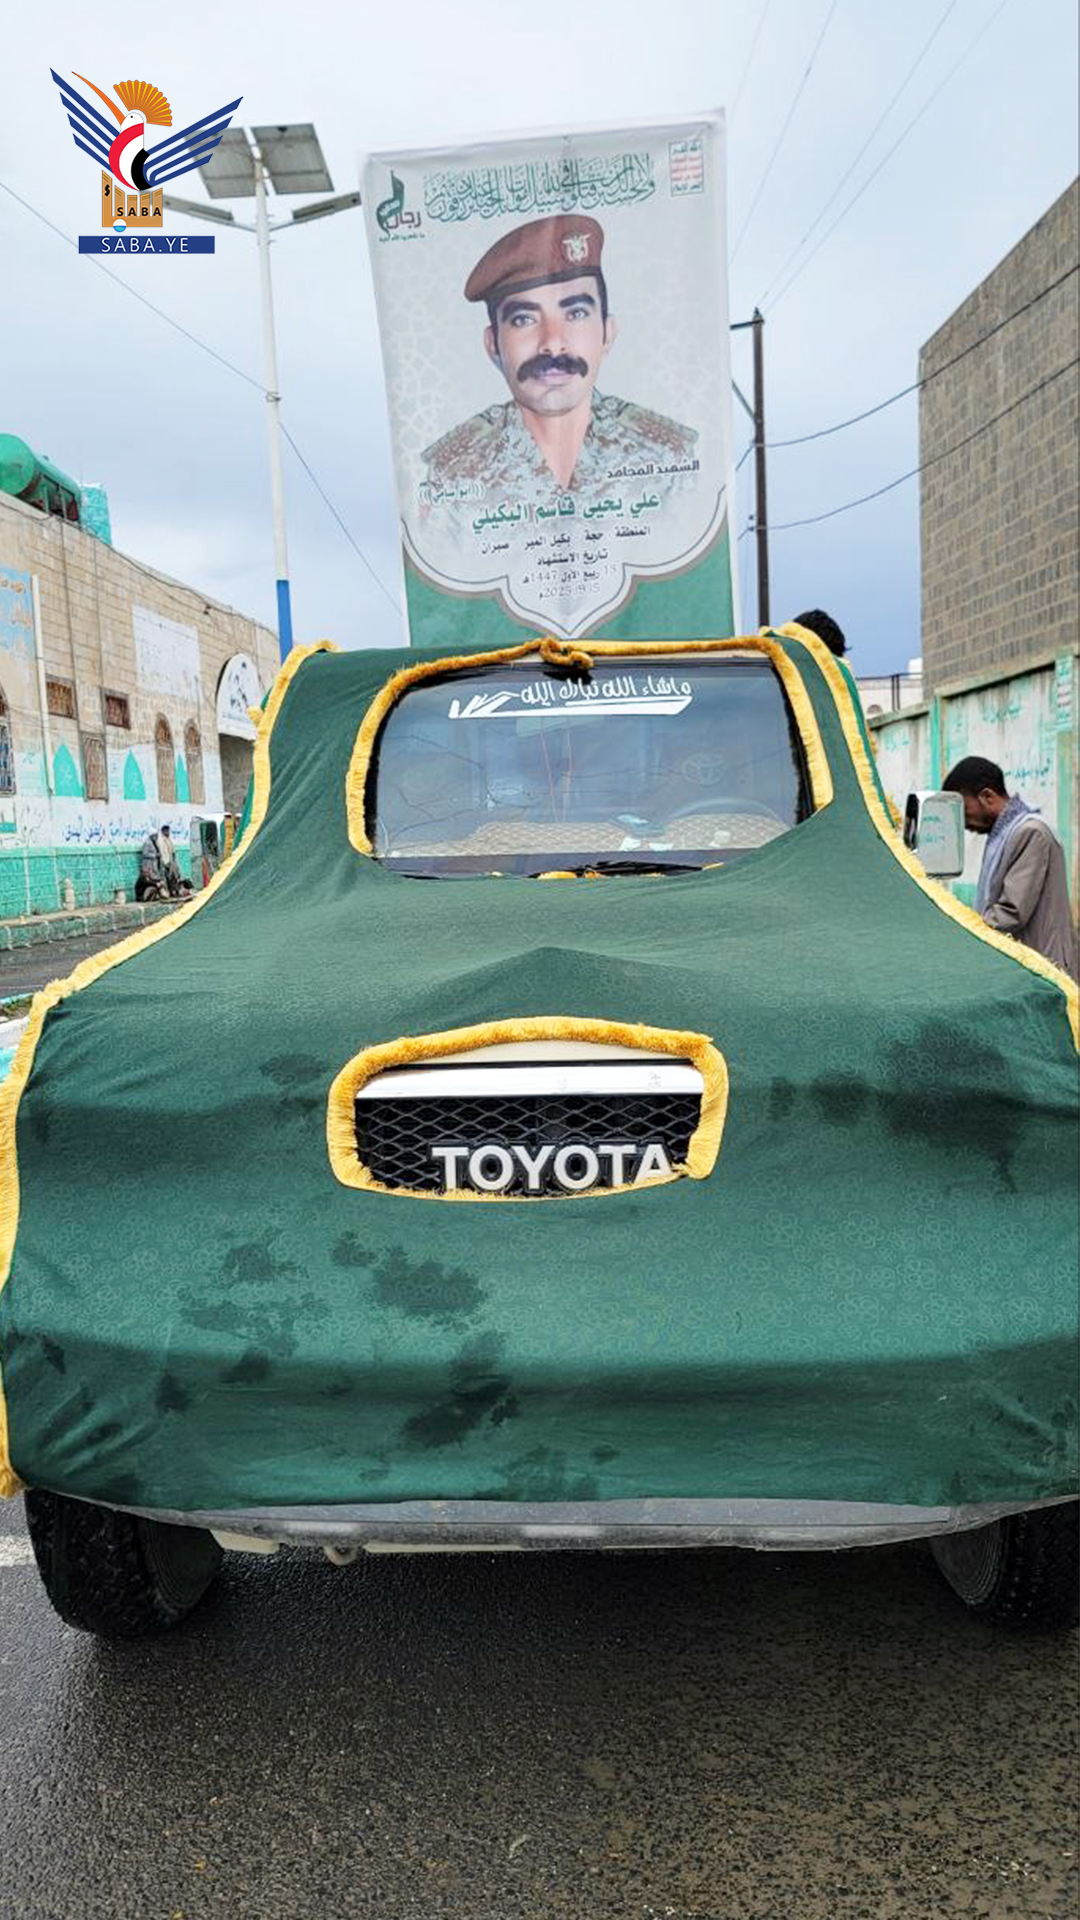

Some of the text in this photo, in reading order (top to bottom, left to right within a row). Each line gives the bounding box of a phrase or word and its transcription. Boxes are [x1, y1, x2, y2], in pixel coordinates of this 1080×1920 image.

[606, 458, 701, 482] الشهيد المجاهد
[472, 493, 660, 535] علي يحيى قاسم البكيلي
[585, 529, 604, 541] حجة
[615, 525, 652, 538] المنطقة
[537, 549, 609, 567] تاريخ الاستشهاد
[584, 569, 601, 582] ربيع
[559, 679, 600, 701] تبارك
[601, 676, 638, 699] الله
[431, 1144, 672, 1194] TOYOTA
